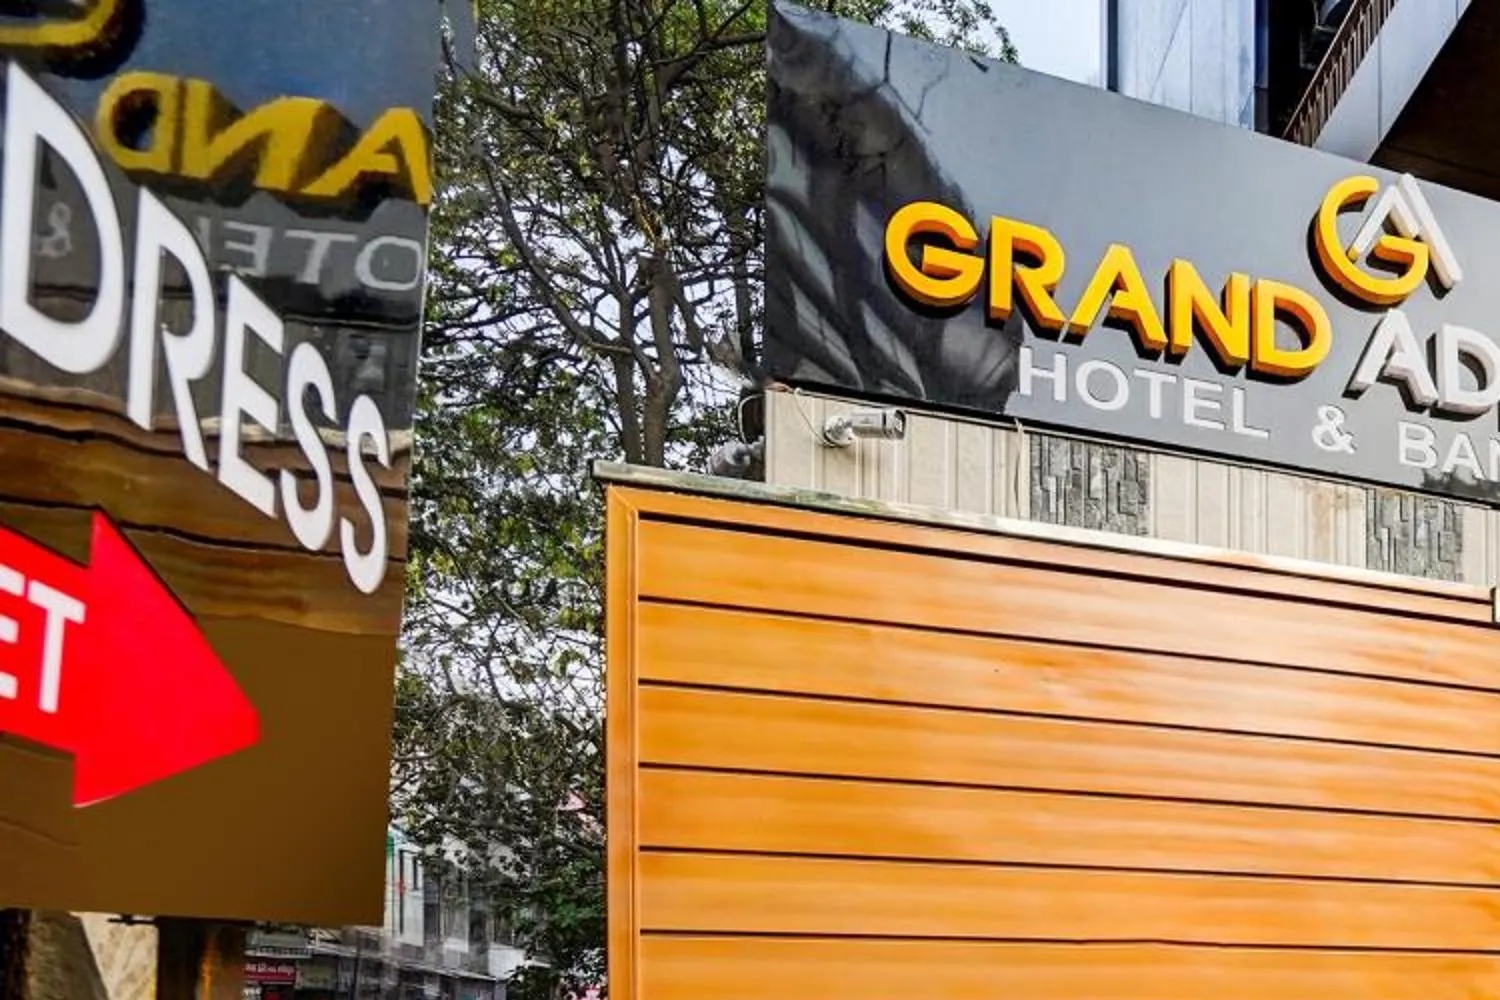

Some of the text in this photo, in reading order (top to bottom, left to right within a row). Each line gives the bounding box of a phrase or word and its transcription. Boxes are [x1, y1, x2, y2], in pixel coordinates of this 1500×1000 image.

[885, 201, 1331, 378] GRAND
[1017, 346, 1269, 440] HOTEL
[1311, 405, 1357, 455] &
